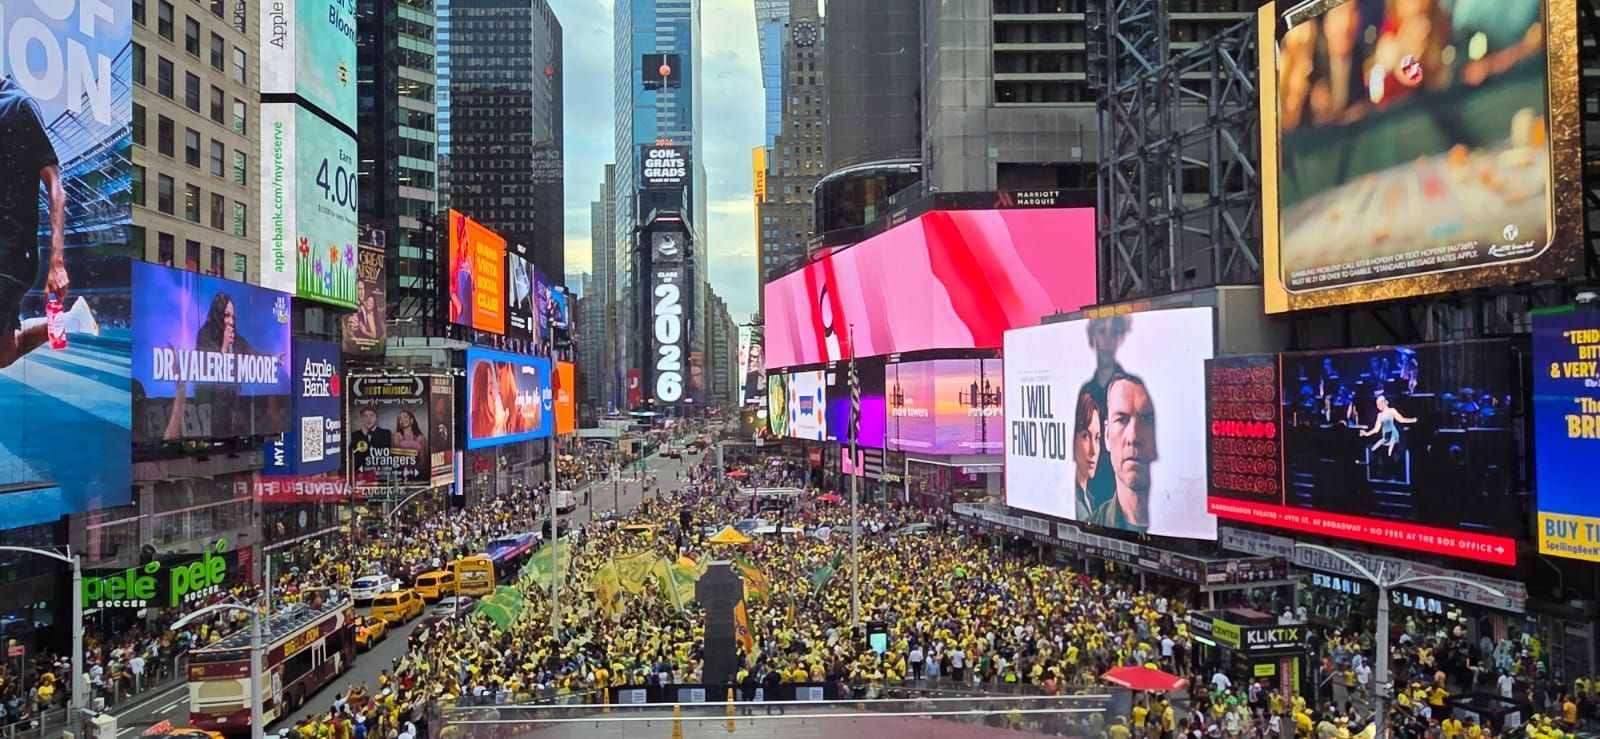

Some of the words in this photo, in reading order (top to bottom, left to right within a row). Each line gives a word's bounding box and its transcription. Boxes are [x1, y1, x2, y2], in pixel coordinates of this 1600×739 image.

[270, 2, 287, 50] Apple
[645, 158, 685, 168] GRATS
[649, 149, 681, 159] CON-
[644, 168, 686, 178] GRADS
[316, 158, 357, 212] 4.00
[272, 121, 283, 273] applebank.com/myreserve
[1407, 257, 1435, 267] MESSAGE
[1437, 254, 1456, 262] RATES
[1457, 250, 1479, 259] APPLY.
[654, 284, 682, 402] 2026
[179, 350, 235, 383] VALERIE
[237, 354, 278, 384] MOORE
[303, 357, 332, 377] Apple
[1211, 366, 1275, 384] CHICAGO
[1550, 362, 1560, 378] &
[303, 378, 330, 397] Bank
[1211, 384, 1275, 401] CHICAGO
[1021, 384, 1026, 419] I
[1026, 384, 1054, 419] WILL
[1211, 402, 1275, 420] CHICAGO
[1212, 420, 1276, 438] CHICAGO
[1012, 420, 1038, 458] FIND
[1039, 423, 1067, 460] YOU
[1212, 438, 1276, 457] CHICAGO
[369, 446, 390, 457] two
[365, 455, 416, 468] strangers
[1212, 455, 1276, 476] CHICAGO
[1212, 472, 1277, 494] CHICAGO
[1322, 519, 1362, 532] BROADWAY
[1370, 527, 1382, 535] NO
[1385, 529, 1404, 539] FEES
[1406, 533, 1417, 541] AT
[1418, 534, 1434, 544] THE
[1437, 537, 1455, 547] BOX
[1458, 540, 1492, 553] OFFICE
[1545, 518, 1579, 539] BUY
[1103, 550, 1131, 563] OFFLINE
[170, 537, 228, 608] pelé
[81, 560, 161, 608] pelé
[97, 599, 147, 607] SOCCER
[1247, 628, 1299, 644] KLIKTIX
